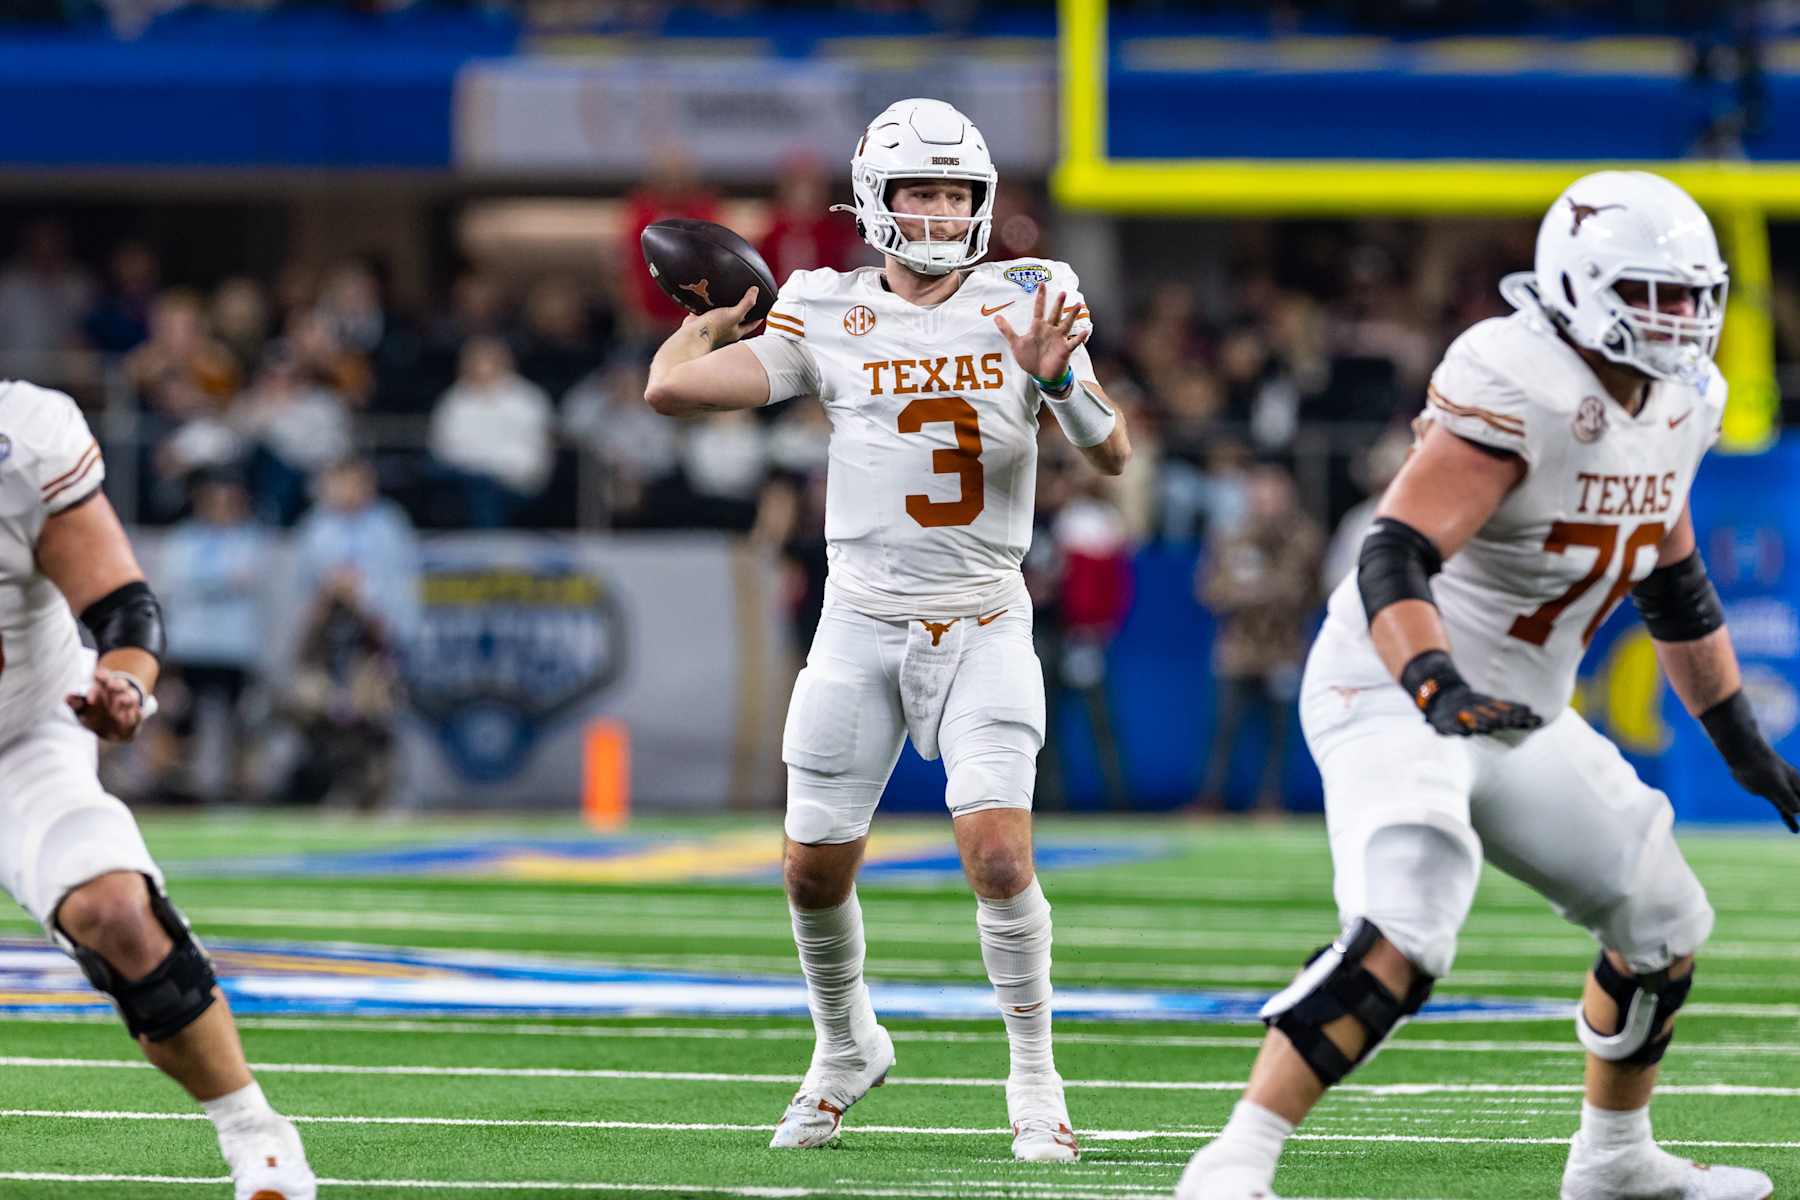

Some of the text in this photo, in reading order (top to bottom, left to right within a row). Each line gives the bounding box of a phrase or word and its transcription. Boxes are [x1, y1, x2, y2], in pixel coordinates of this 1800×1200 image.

[931, 156, 960, 166] HORNS
[844, 307, 876, 334] SEC
[863, 353, 1004, 395] TEXAS
[897, 396, 985, 528] 3
[1576, 471, 1676, 515] TEXAS
